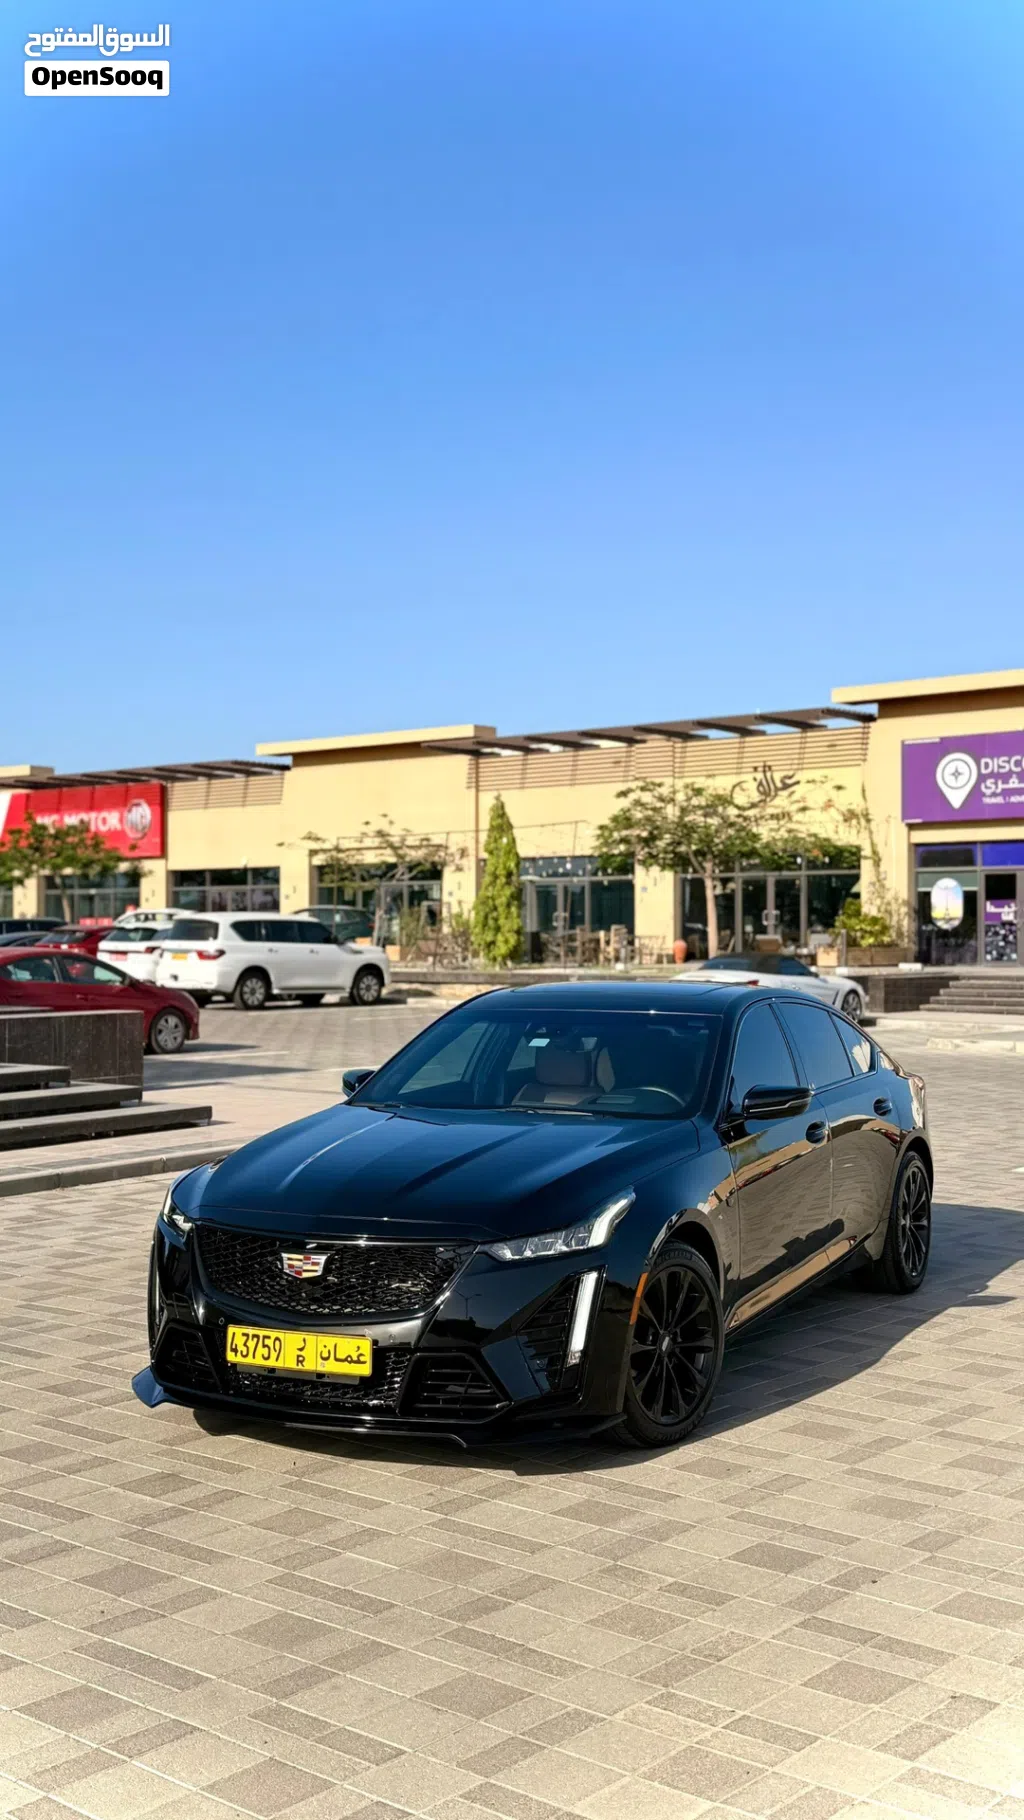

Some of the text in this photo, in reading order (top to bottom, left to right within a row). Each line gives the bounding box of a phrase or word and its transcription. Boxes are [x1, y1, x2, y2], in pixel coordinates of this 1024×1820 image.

[980, 755, 1024, 774] DISC
[229, 1331, 282, 1362] 43759
[296, 1354, 305, 1367] R
